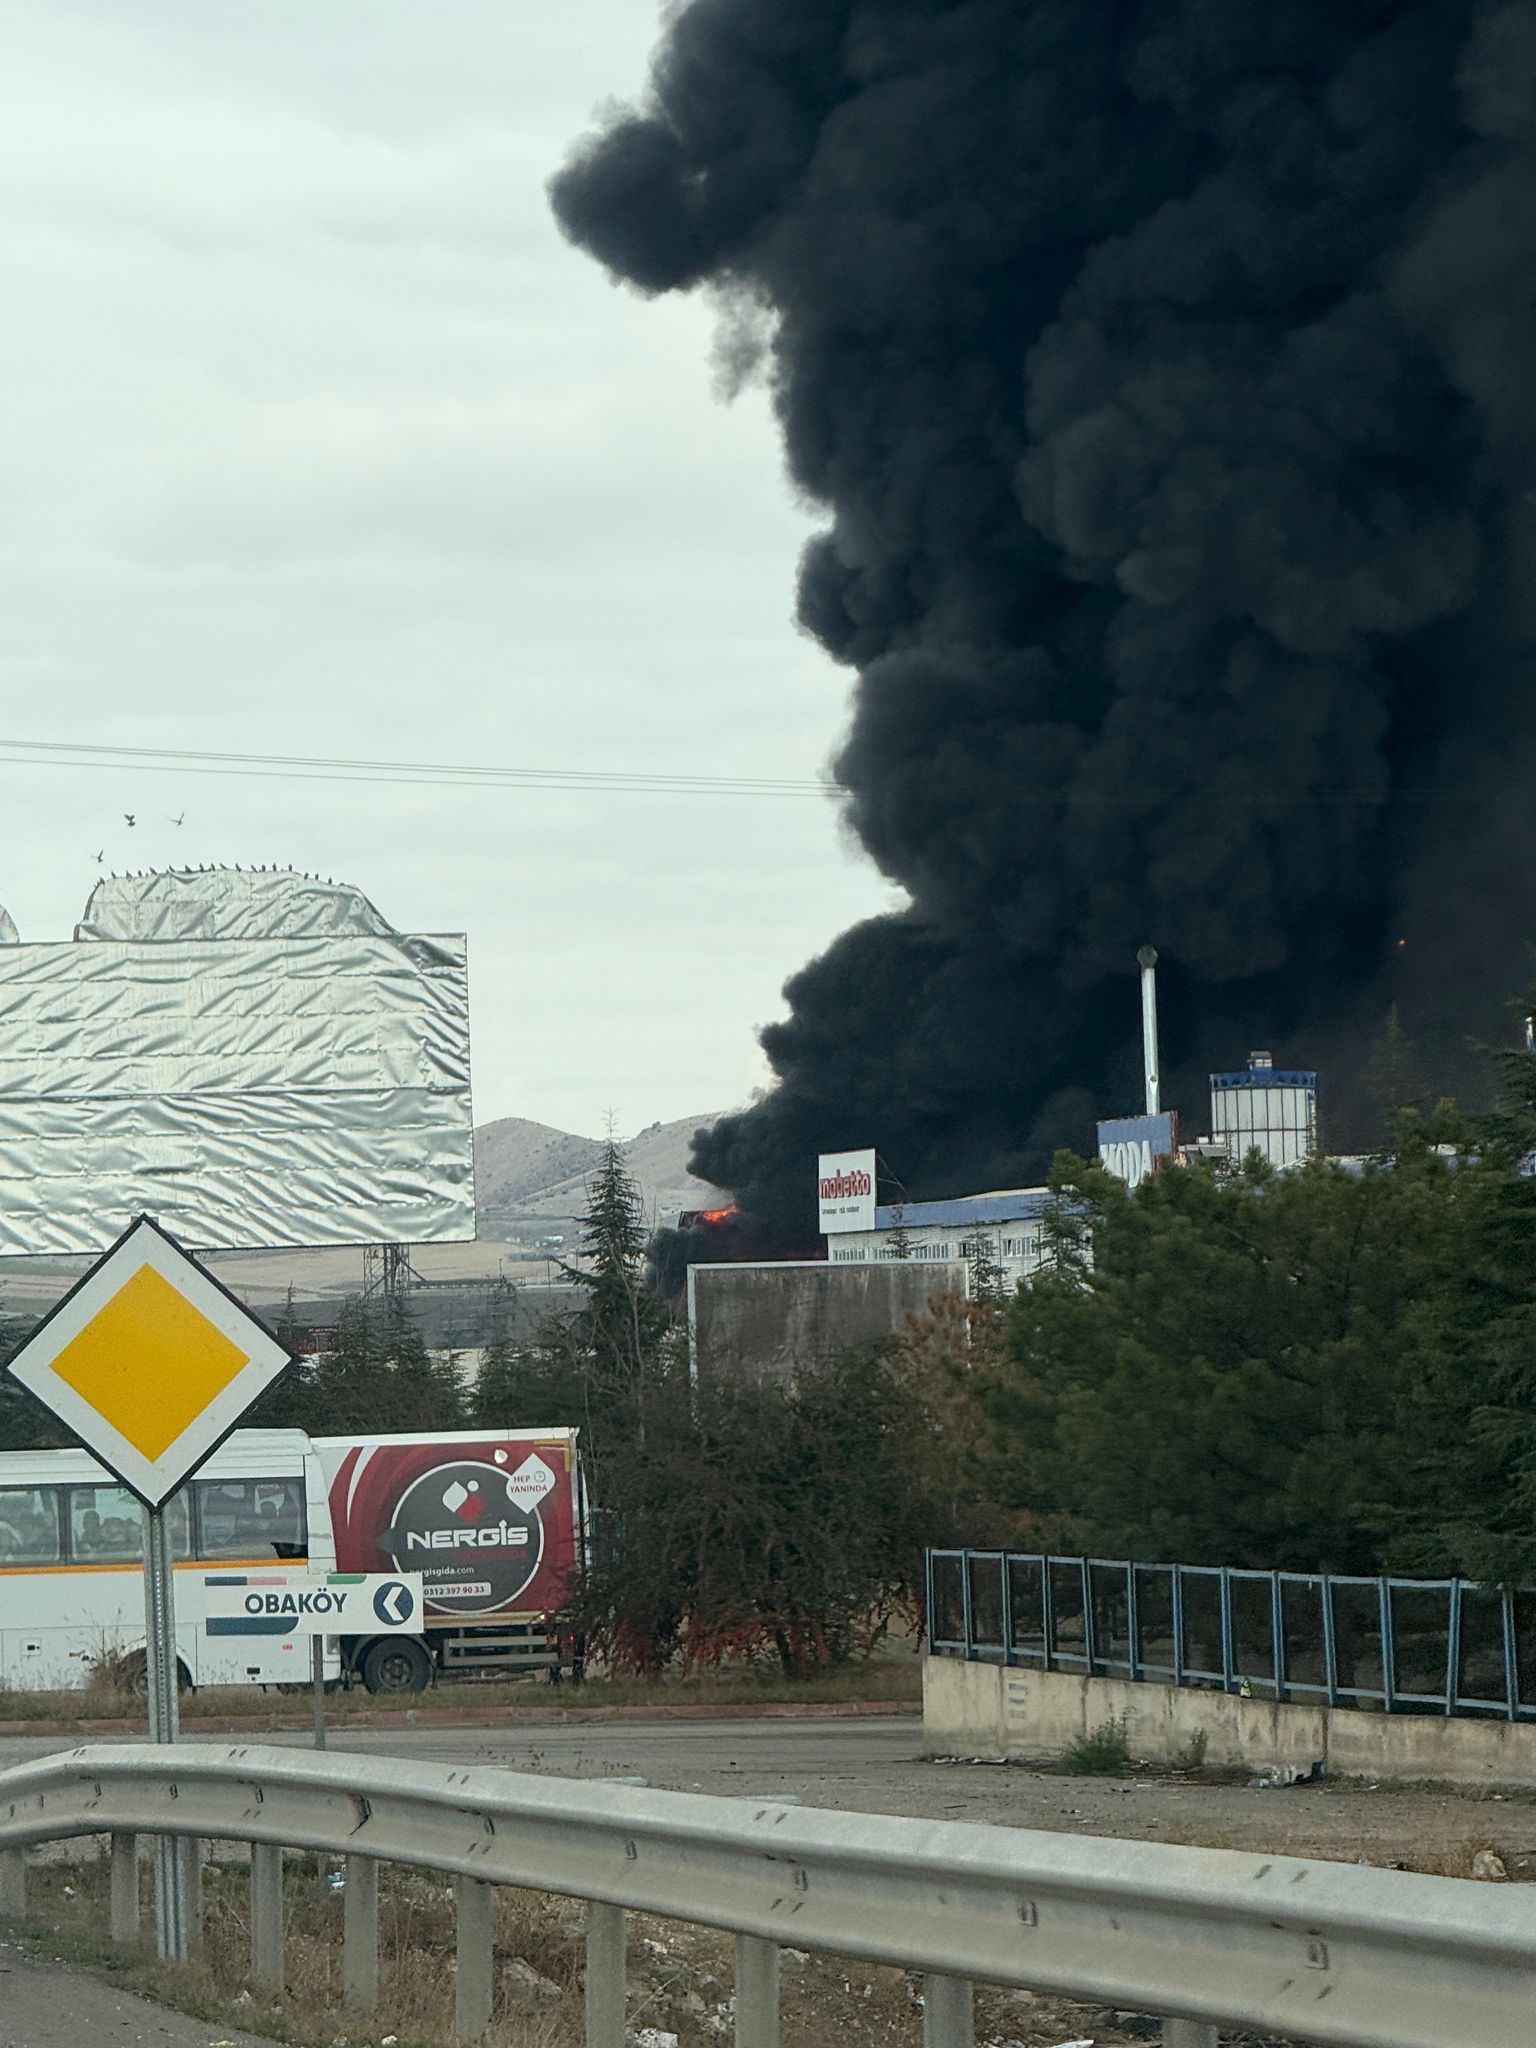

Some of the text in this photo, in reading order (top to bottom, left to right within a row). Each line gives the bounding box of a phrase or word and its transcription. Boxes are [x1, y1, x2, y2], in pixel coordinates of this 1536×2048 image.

[510, 1485, 547, 1493] YANINDA
[446, 1587, 460, 1595] 397
[463, 1586, 473, 1594] 90
[475, 1585, 484, 1593] 33
[244, 1587, 348, 1614] OBAKÖY
